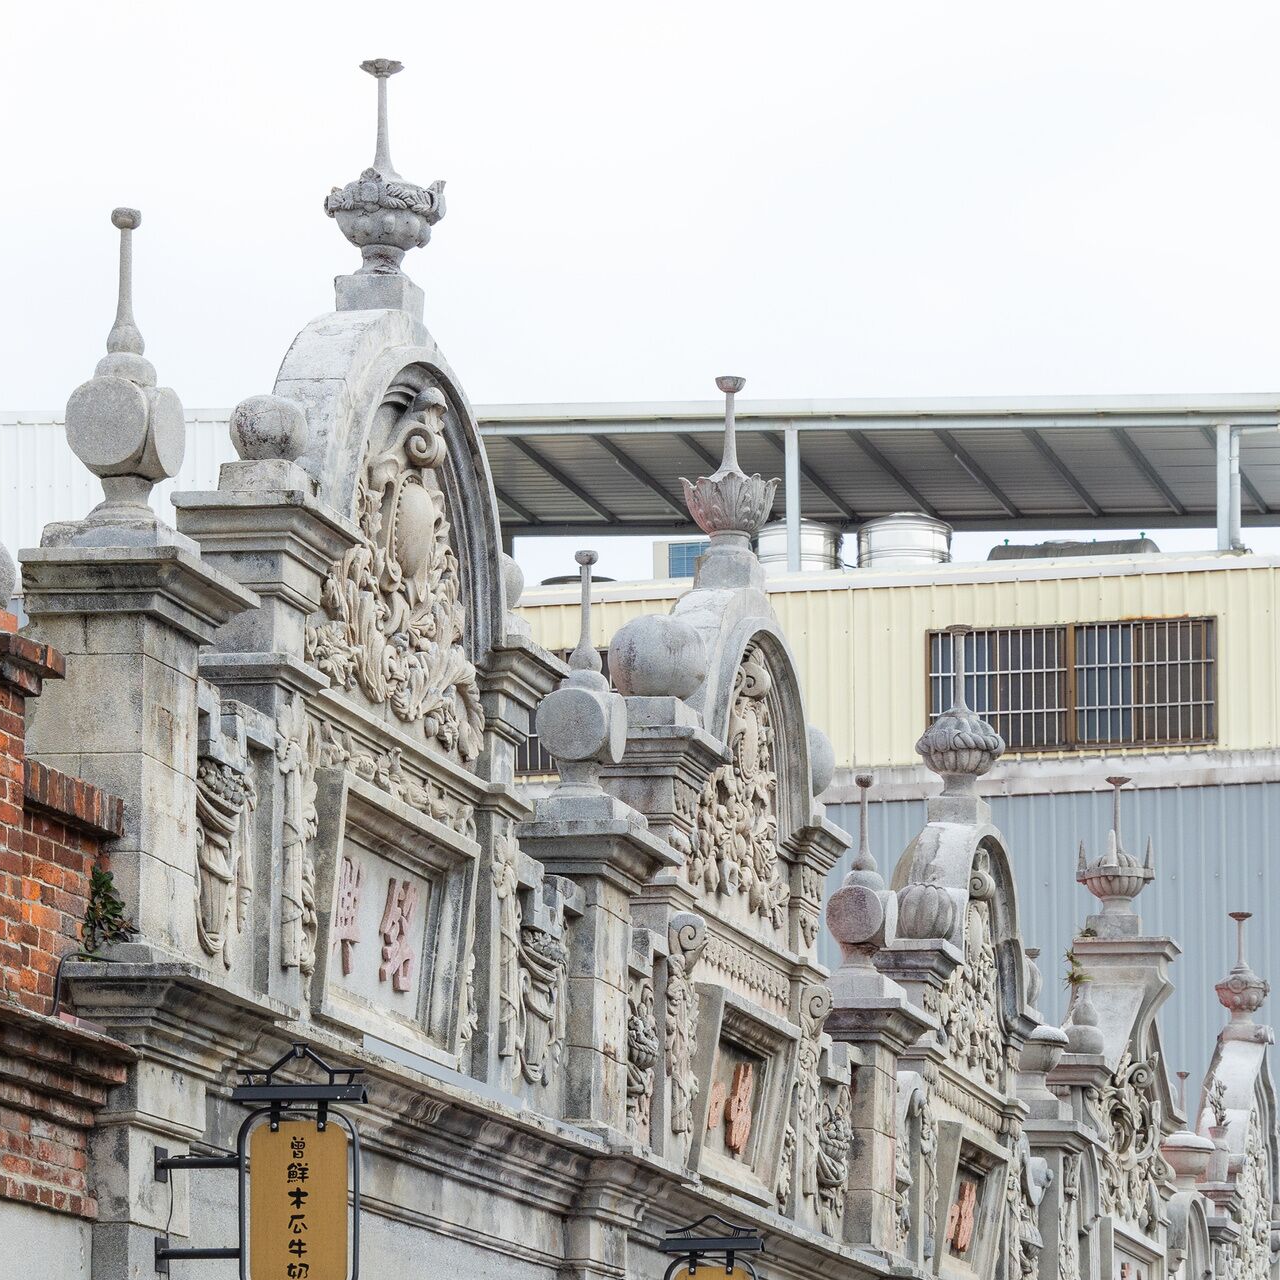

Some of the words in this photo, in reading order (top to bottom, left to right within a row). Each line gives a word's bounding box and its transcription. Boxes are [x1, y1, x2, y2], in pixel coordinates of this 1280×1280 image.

[285, 1135, 312, 1280] 曾鮮木瓜牛奶
